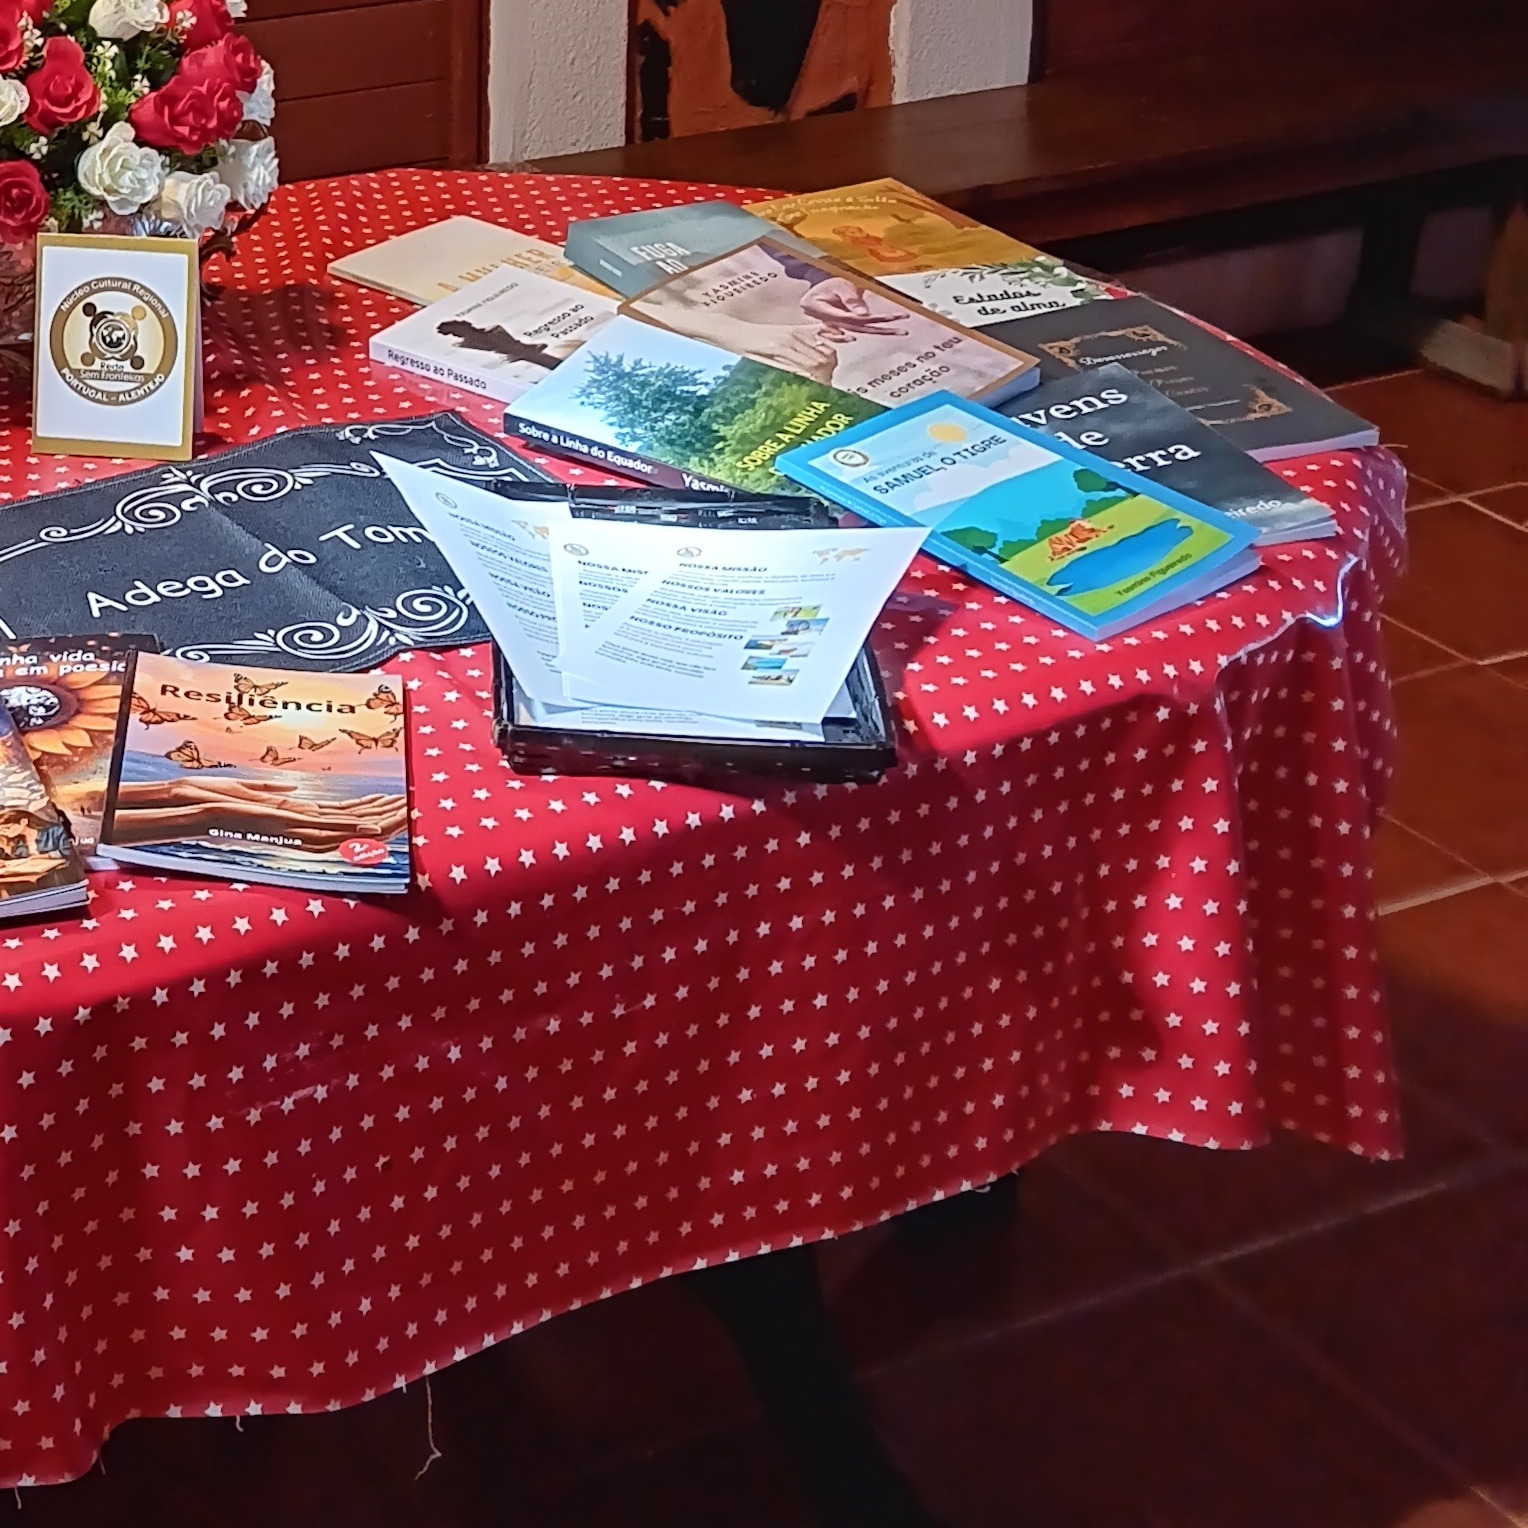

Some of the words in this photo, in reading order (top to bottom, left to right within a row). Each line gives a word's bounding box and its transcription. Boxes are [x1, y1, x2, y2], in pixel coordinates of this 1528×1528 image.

[630, 241, 692, 262] FUGA
[654, 258, 690, 275] AO
[91, 279, 132, 291] Cultural
[132, 283, 170, 319] Regional
[952, 288, 1042, 305] Estados
[523, 310, 570, 340] Regresso
[570, 303, 586, 317] ao
[552, 313, 595, 340] Passado
[386, 348, 430, 374] Regresso
[431, 364, 446, 378] ao
[446, 368, 488, 391] Passado
[866, 361, 917, 388] meses
[916, 351, 937, 364] no
[932, 336, 964, 352] teu
[60, 367, 109, 402] PORTUGAL
[118, 373, 166, 403] ALENTEJO
[889, 365, 951, 398] coração
[783, 400, 832, 435] LINHA
[1010, 387, 1129, 429] vens
[775, 430, 796, 444] A
[801, 412, 855, 448] ADOR
[518, 420, 550, 442] Sobre
[550, 434, 560, 445] a
[560, 435, 589, 456] Linha
[589, 444, 606, 460] do
[606, 449, 655, 475] Equador
[735, 438, 786, 471] SOBRE
[872, 461, 945, 495] SAMUEL,
[939, 454, 957, 468] O
[954, 433, 1007, 463] TIGRE
[682, 472, 730, 494] Yasmi
[86, 568, 252, 619] Adega
[258, 541, 318, 574] do
[318, 522, 434, 550] Tom
[14, 663, 49, 676] em
[49, 649, 96, 663] vida
[159, 682, 357, 715] Resiliência
[208, 828, 243, 840] Gina
[246, 831, 303, 846] Manjua
